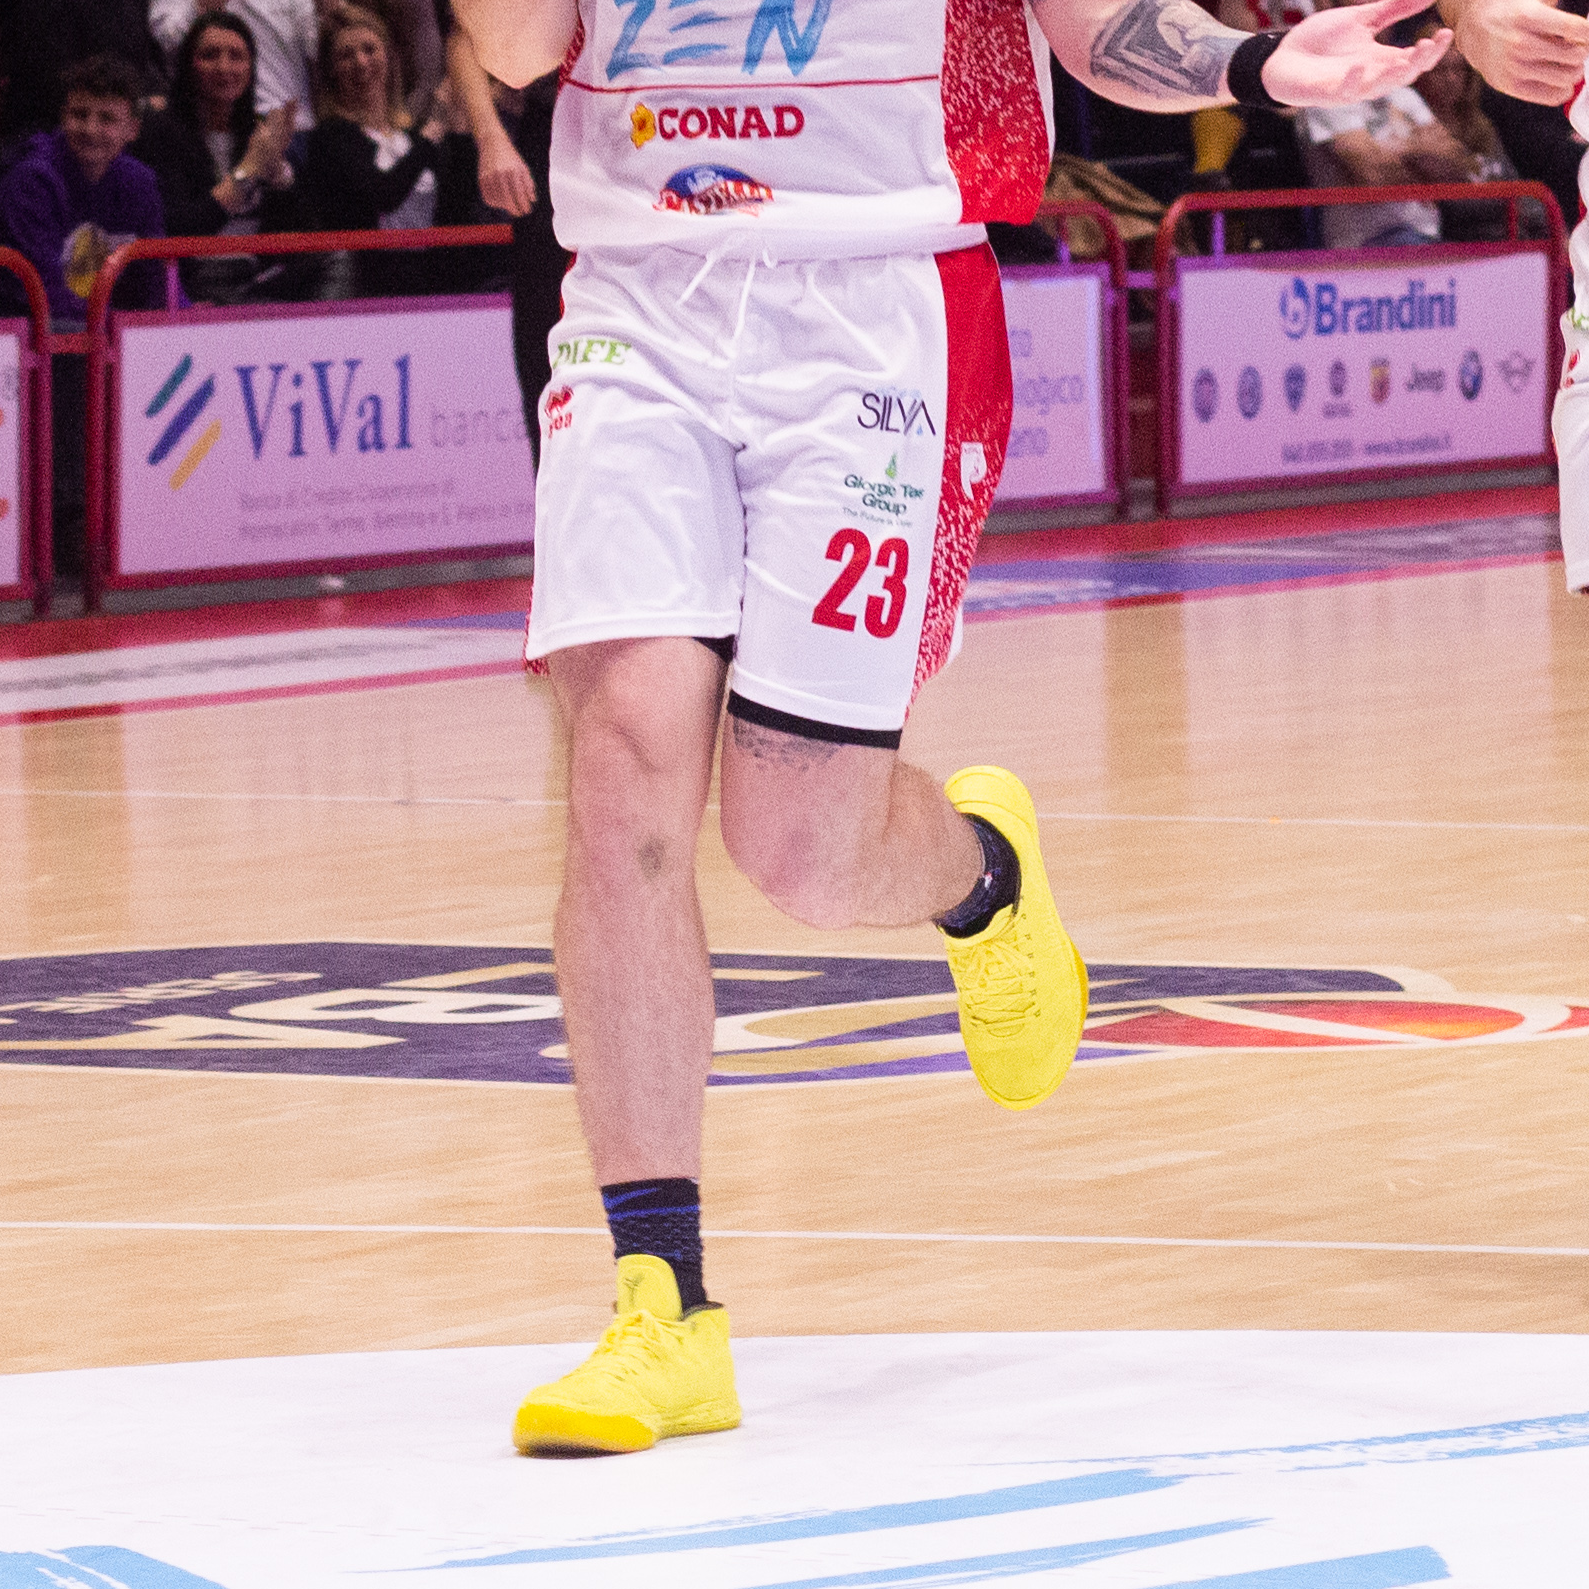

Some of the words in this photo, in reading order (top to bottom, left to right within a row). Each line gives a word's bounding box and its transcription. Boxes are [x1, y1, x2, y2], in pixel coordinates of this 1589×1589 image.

[657, 105, 806, 141] CONAD
[1312, 278, 1458, 336] Brandini
[233, 353, 413, 460] ViVal
[856, 392, 937, 437] SILVA
[862, 492, 908, 517] Group
[811, 525, 911, 640] 23
